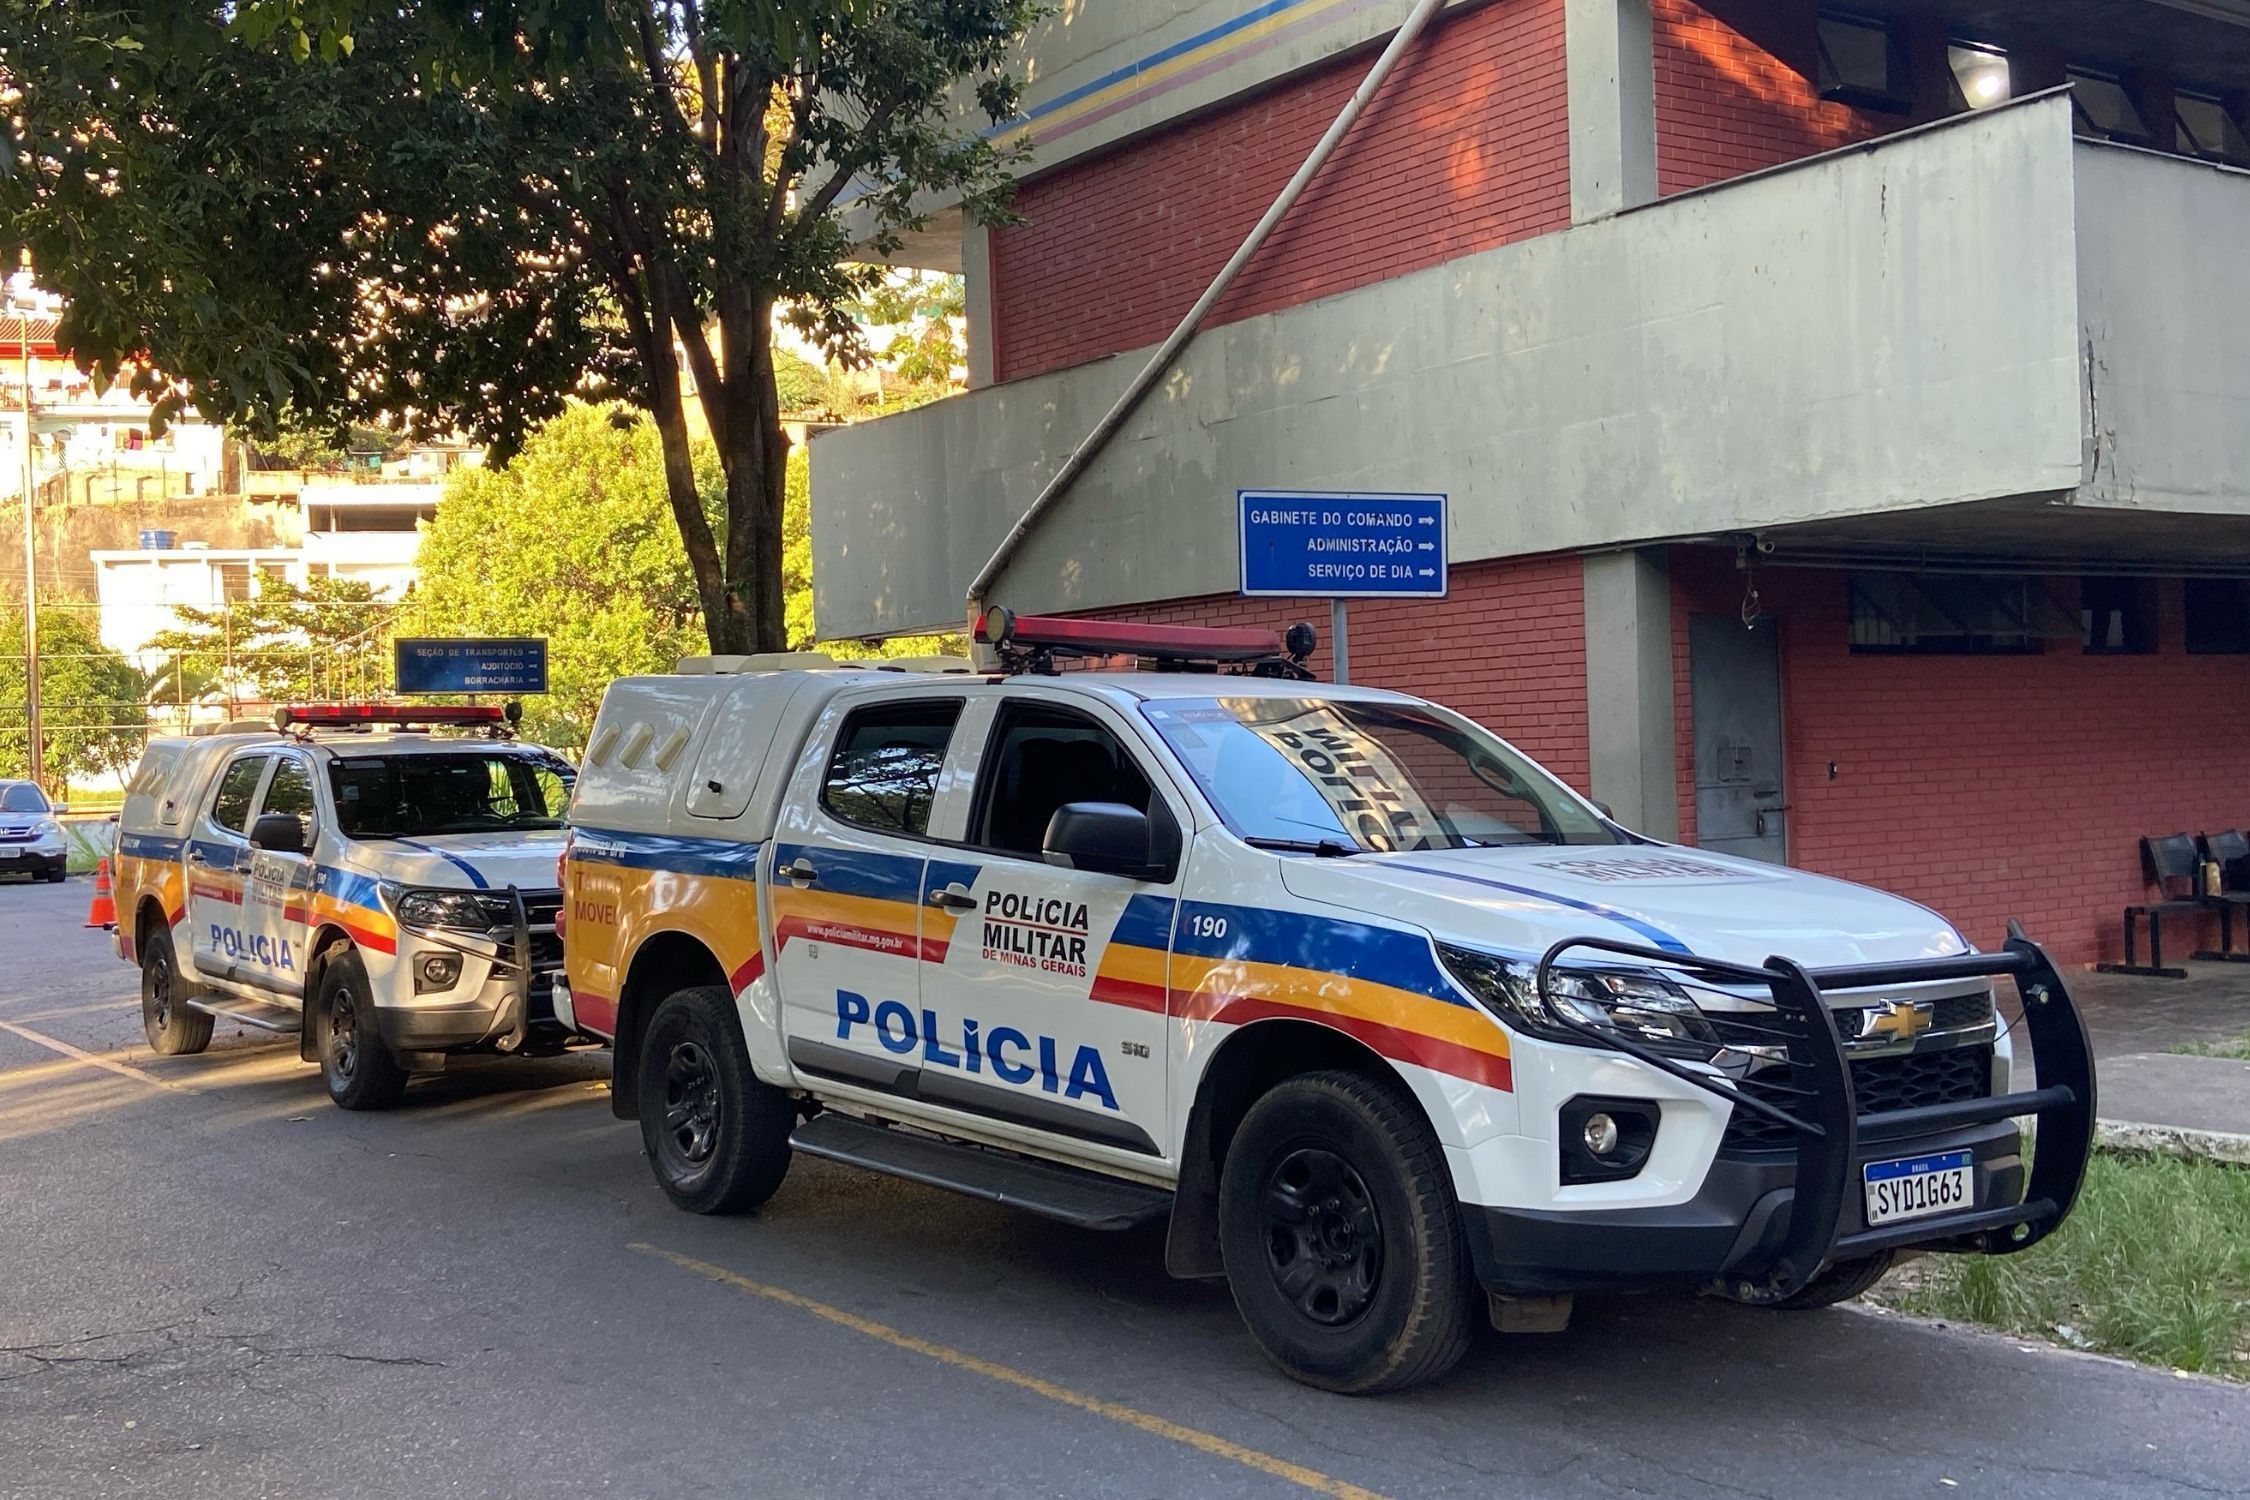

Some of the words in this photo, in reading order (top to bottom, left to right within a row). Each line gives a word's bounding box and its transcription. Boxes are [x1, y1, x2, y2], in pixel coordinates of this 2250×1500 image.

[1251, 510, 1317, 525] GABINETE
[1322, 512, 1341, 526] DO
[1347, 512, 1413, 527] COMANDO
[1307, 536, 1413, 555] ADMINISTRAÇÃO
[1308, 563, 1365, 580] SERVIÇO
[1370, 564, 1387, 578] DE
[1391, 565, 1413, 579] DIA
[416, 646, 444, 658] SEÇÃO
[448, 648, 460, 657] DE
[464, 676, 524, 685] BORRACHARIA
[1193, 915, 1227, 938] 190
[983, 922, 1086, 965] MILITAR
[982, 948, 997, 961] DE
[1000, 951, 1037, 969] MINAS
[1041, 959, 1087, 978] GERAIS
[1877, 1170, 1963, 1215] SYD1G63
